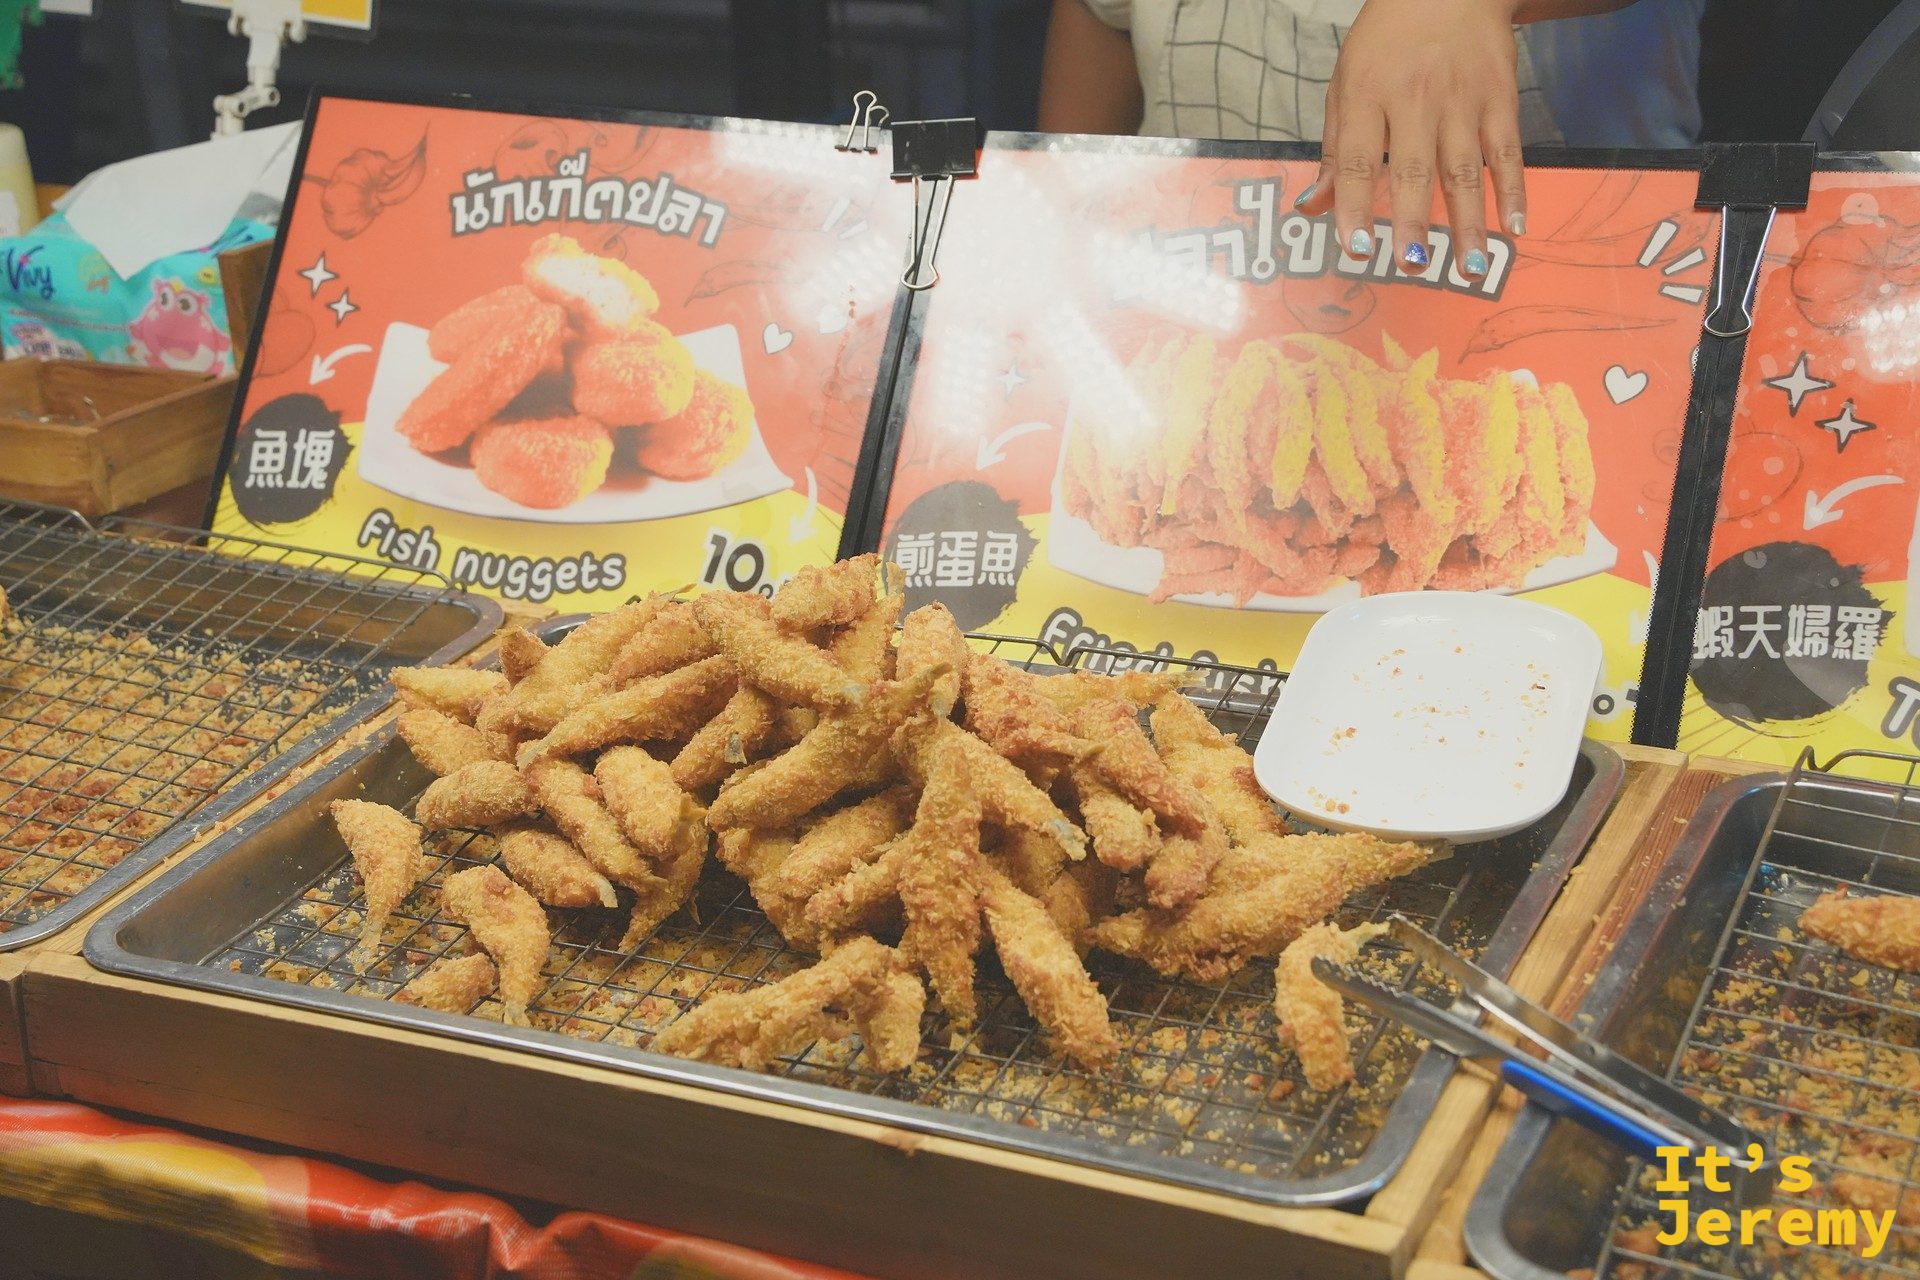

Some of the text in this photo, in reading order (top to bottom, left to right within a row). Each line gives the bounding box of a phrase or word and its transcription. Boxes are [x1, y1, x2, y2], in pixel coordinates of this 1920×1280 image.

[244, 427, 336, 490] 魚塊
[359, 509, 627, 602] Fish nuggets
[896, 530, 1019, 588] 煎蛋魚
[1692, 603, 1883, 661] 蝦天婦羅
